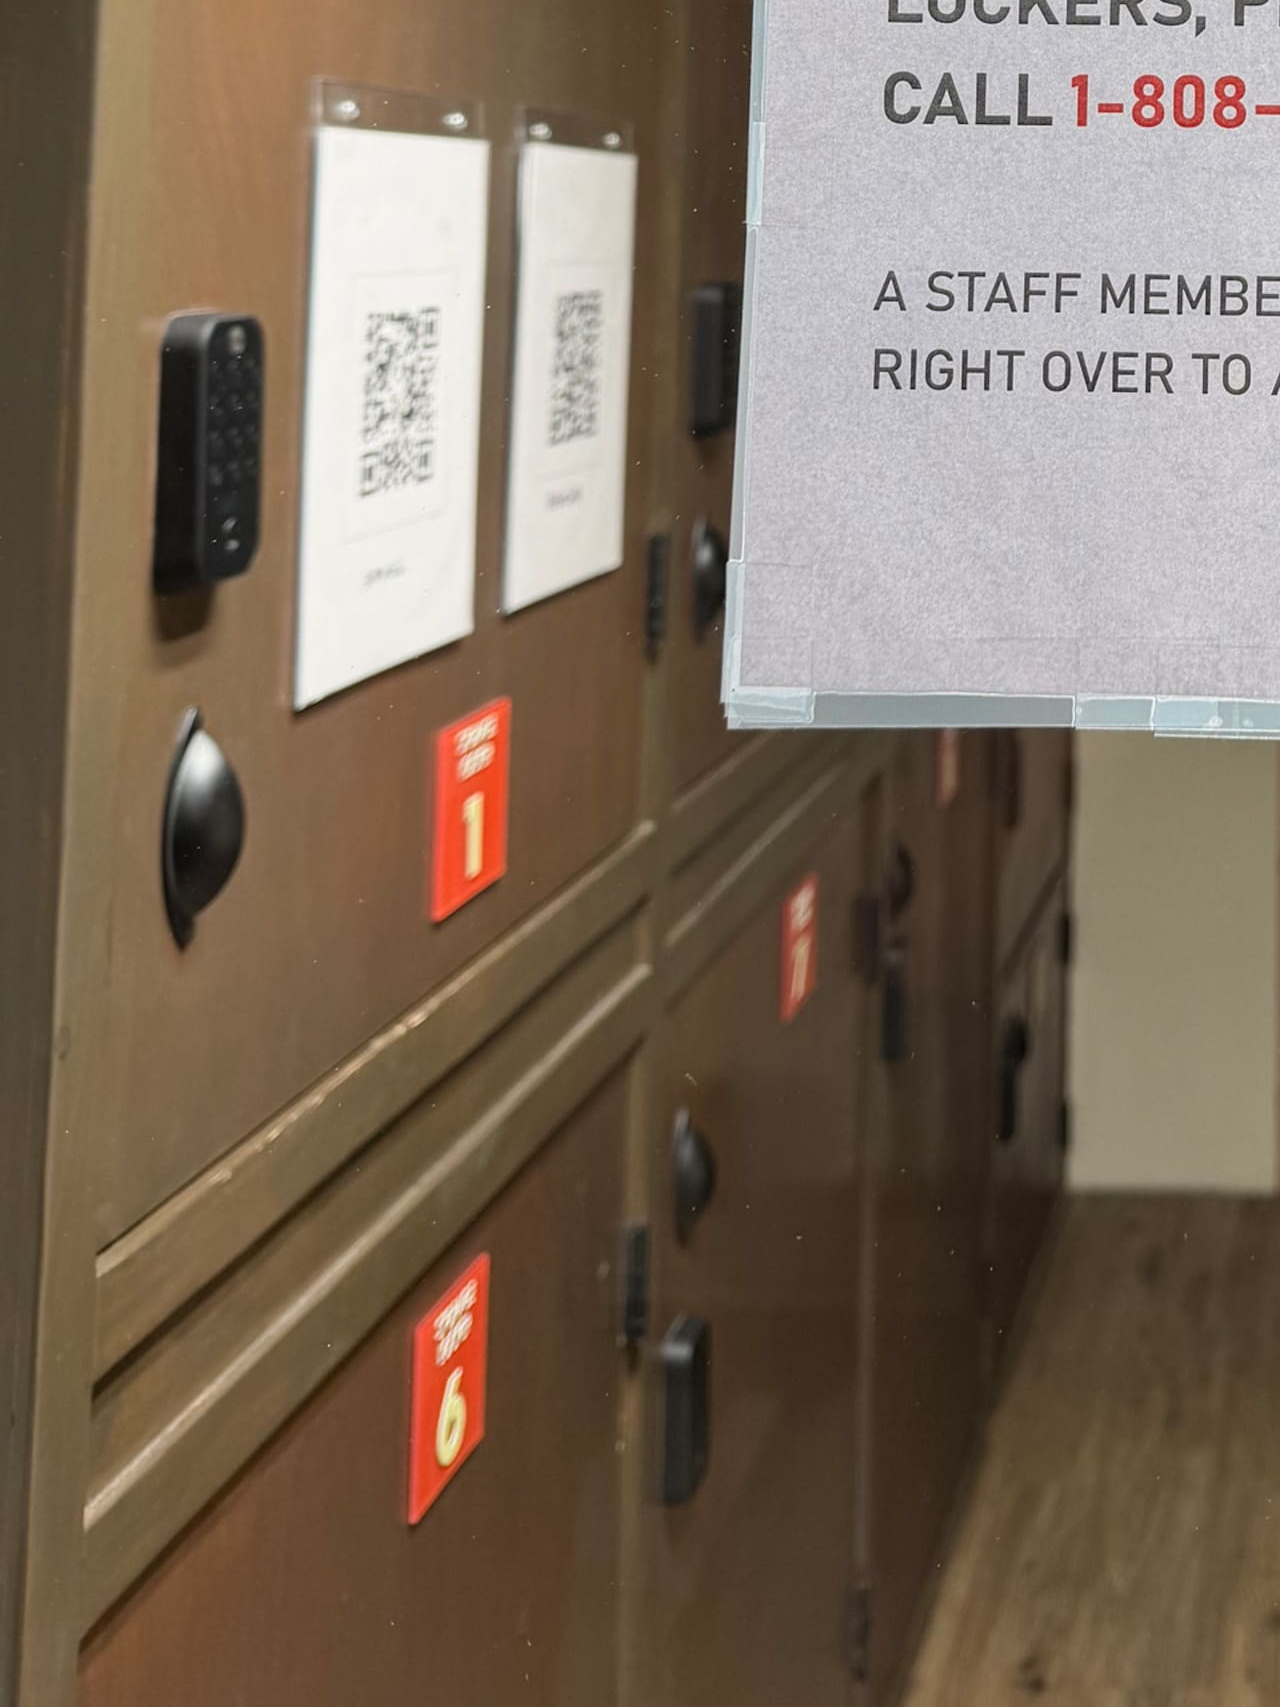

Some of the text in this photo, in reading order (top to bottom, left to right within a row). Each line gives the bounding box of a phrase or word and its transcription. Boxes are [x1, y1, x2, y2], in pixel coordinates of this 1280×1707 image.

[884, 71, 1053, 126] CALL
[873, 271, 906, 311] A
[926, 271, 1081, 313] STAFF
[873, 349, 1025, 392] RIGHT
[1042, 351, 1174, 394] OVER
[1191, 353, 1251, 396] TO
[462, 791, 485, 881] 1
[435, 1366, 467, 1468] 6
